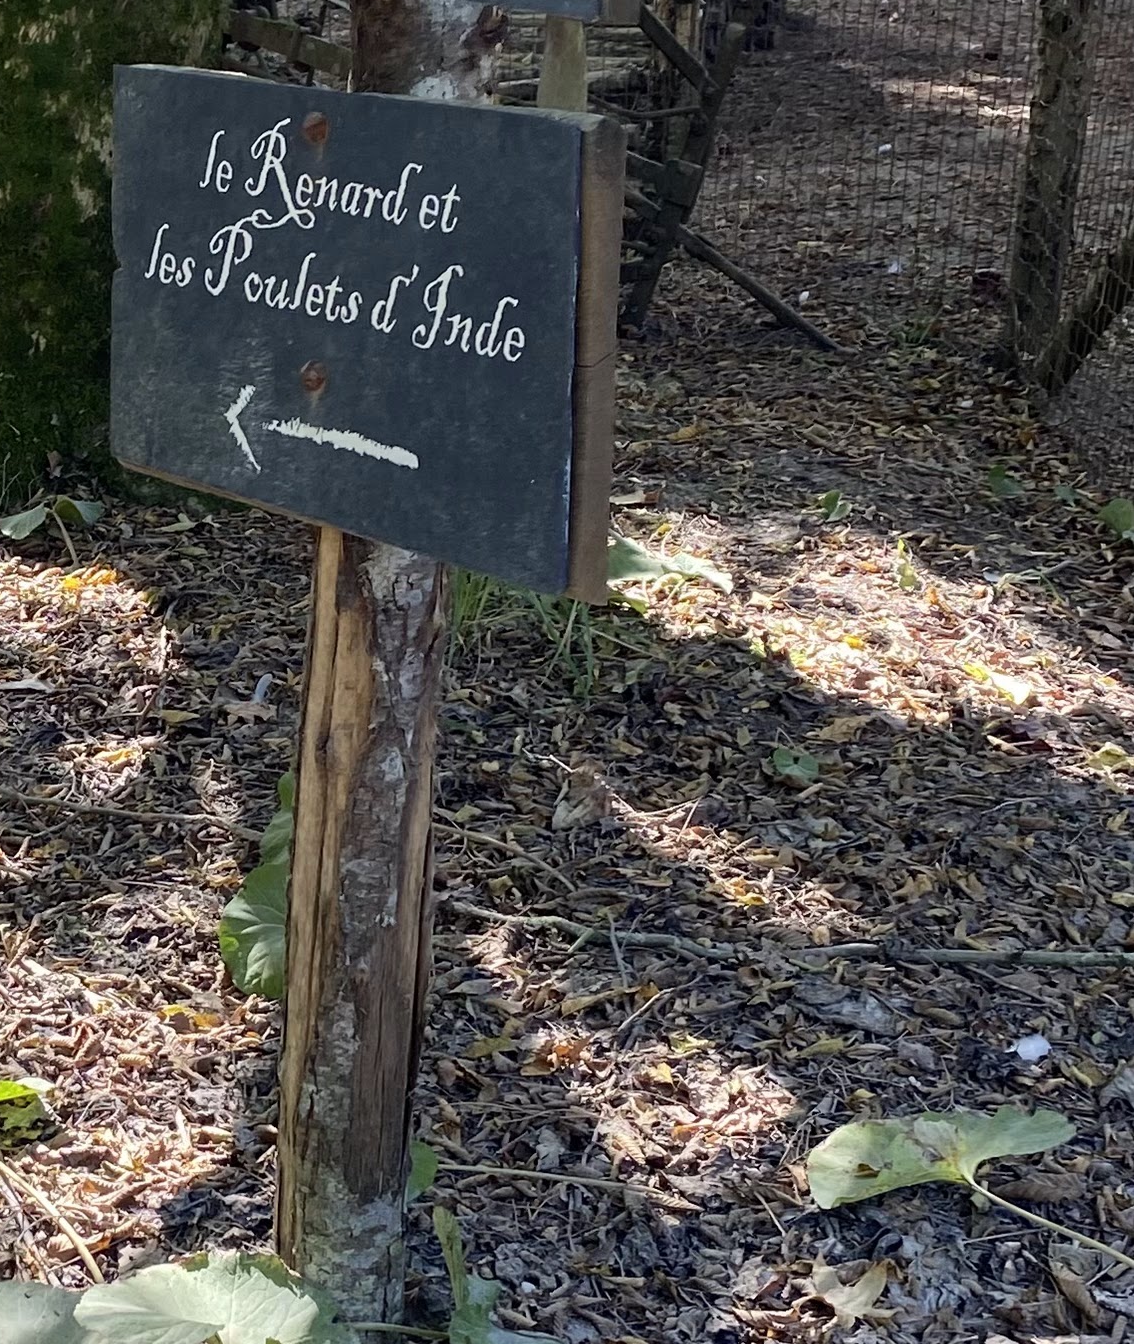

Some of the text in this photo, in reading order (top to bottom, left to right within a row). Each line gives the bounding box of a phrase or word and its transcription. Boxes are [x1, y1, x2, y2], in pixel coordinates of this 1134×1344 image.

[199, 117, 461, 233] le Renard et
[144, 223, 196, 287] les
[204, 216, 364, 324] Poulets
